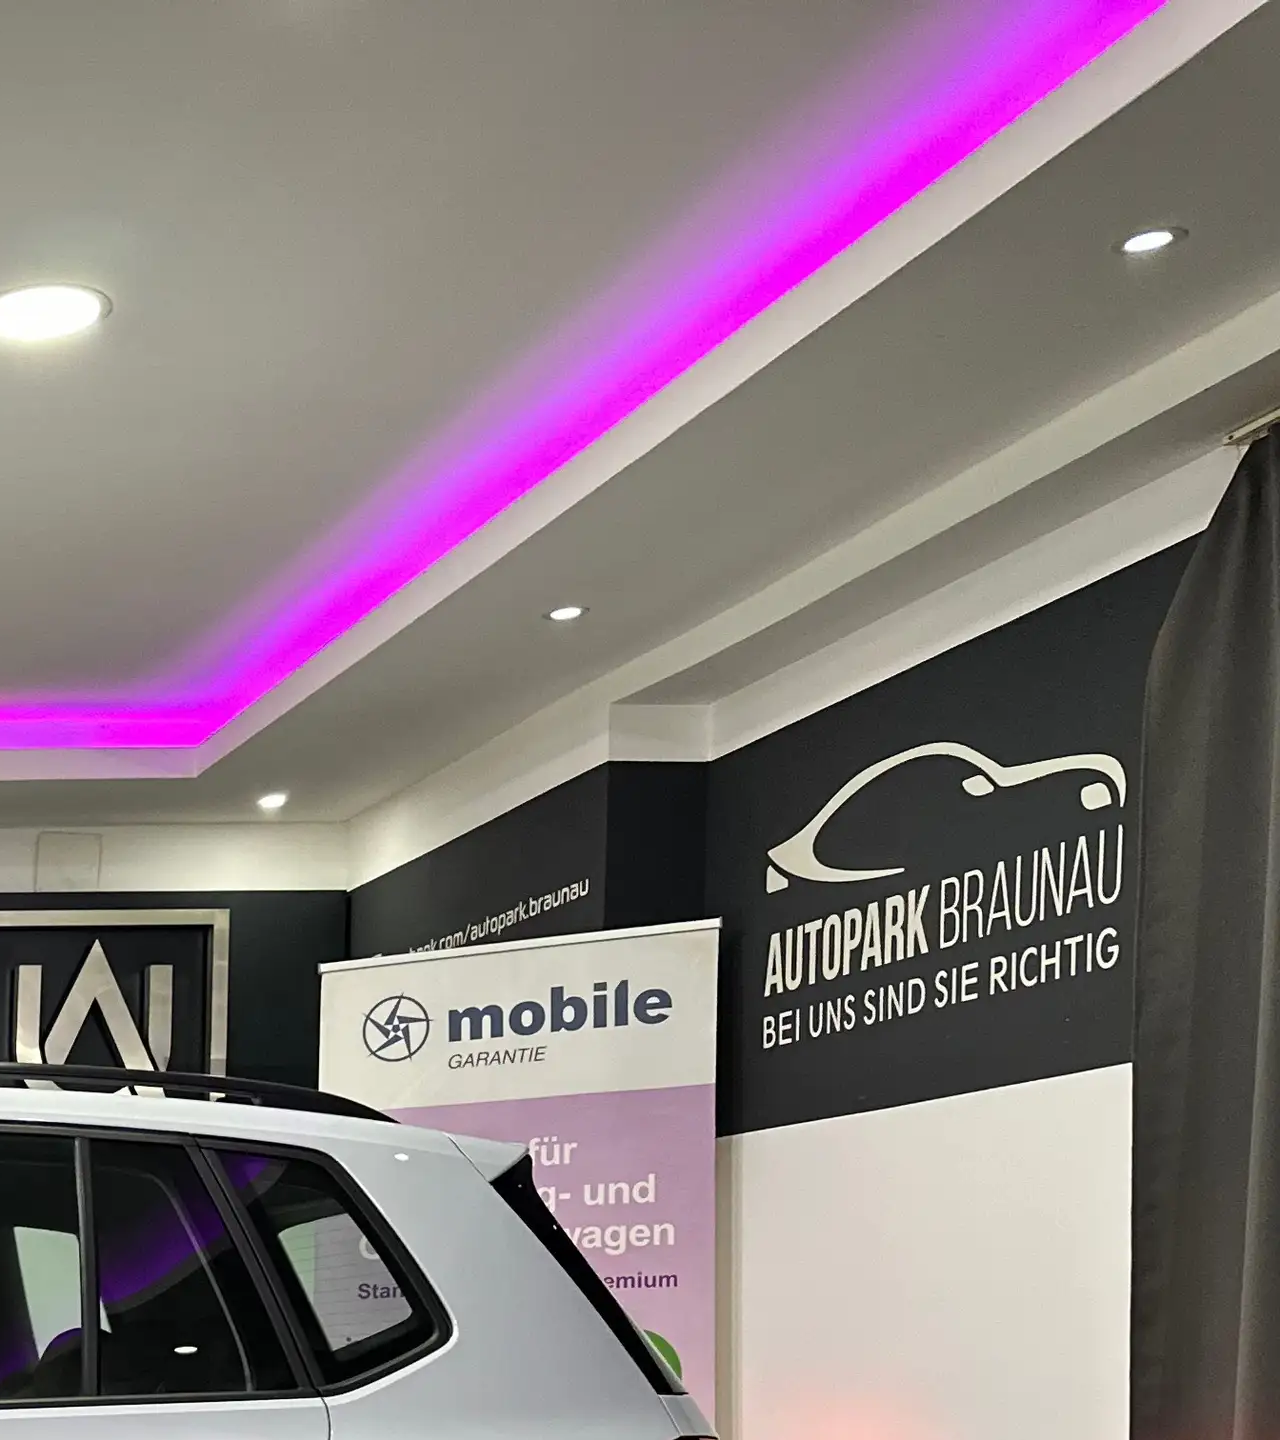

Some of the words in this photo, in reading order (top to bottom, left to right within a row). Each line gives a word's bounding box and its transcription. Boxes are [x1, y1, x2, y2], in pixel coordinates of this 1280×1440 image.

[764, 884, 931, 997] AUTOPARK
[939, 824, 1124, 949] BRAUNAU
[448, 979, 673, 1042] mobile
[763, 1008, 801, 1049] BEI
[809, 994, 857, 1038] UNS
[864, 977, 926, 1026] SIND
[934, 962, 979, 1008] SIE
[989, 927, 1120, 995] RICHTIG
[448, 1045, 548, 1070] GARANTIE
[529, 1135, 578, 1167] für
[583, 1173, 657, 1206] und
